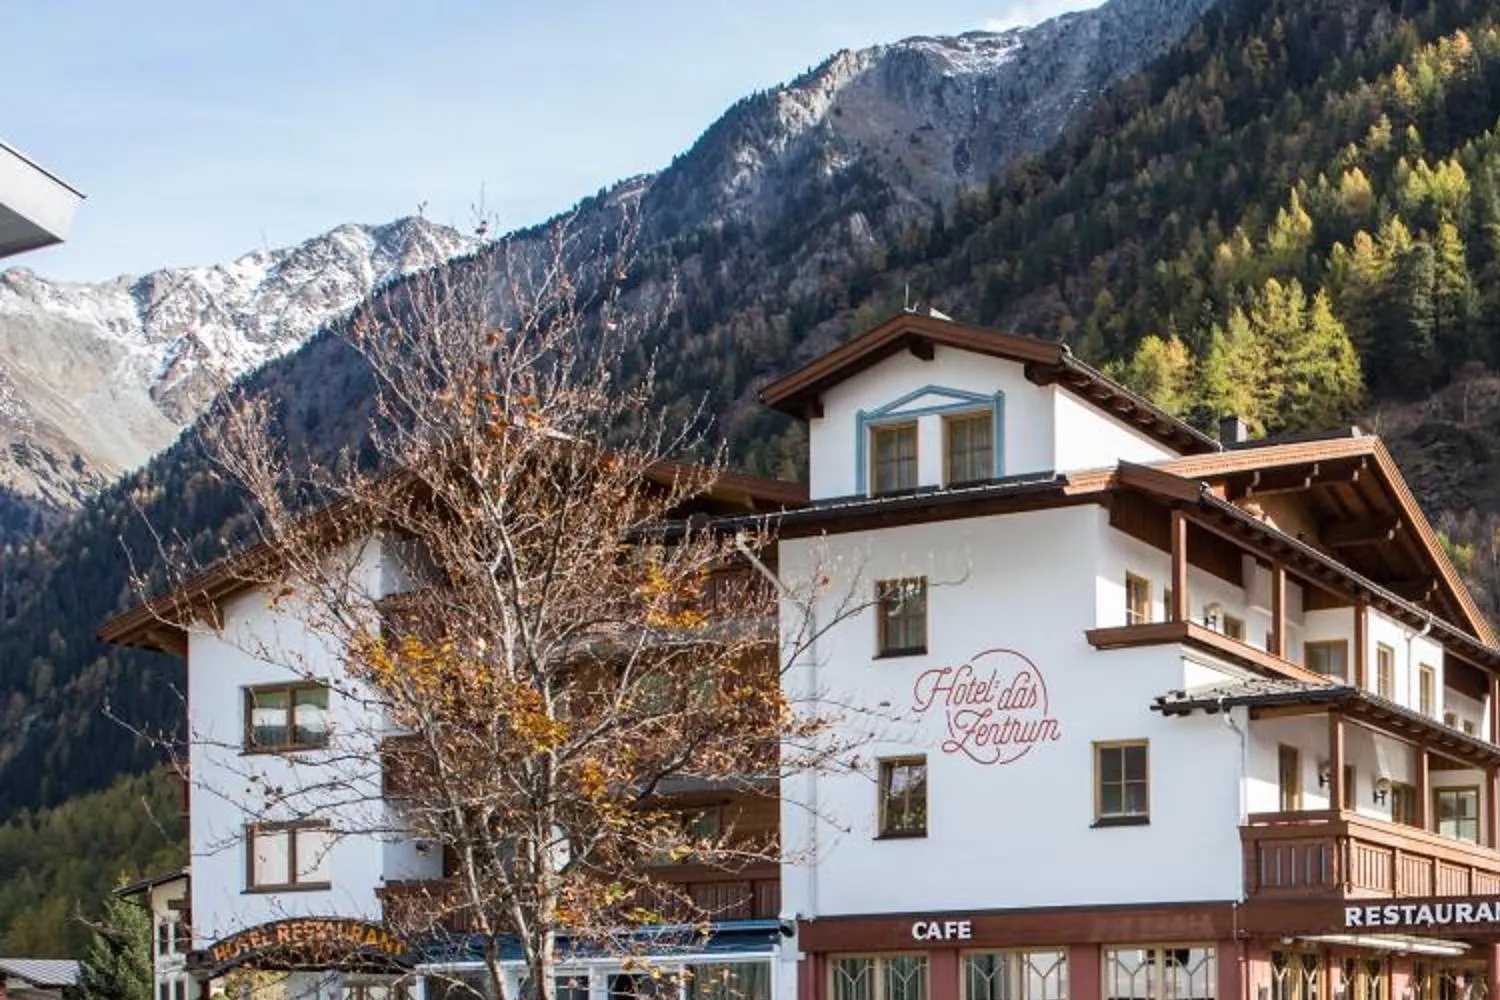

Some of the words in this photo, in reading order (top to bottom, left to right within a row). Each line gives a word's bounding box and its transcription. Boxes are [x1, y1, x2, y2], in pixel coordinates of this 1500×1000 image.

[997, 671, 1037, 711] das
[941, 708, 1061, 765] Zentrum
[911, 920, 972, 940] CAFE
